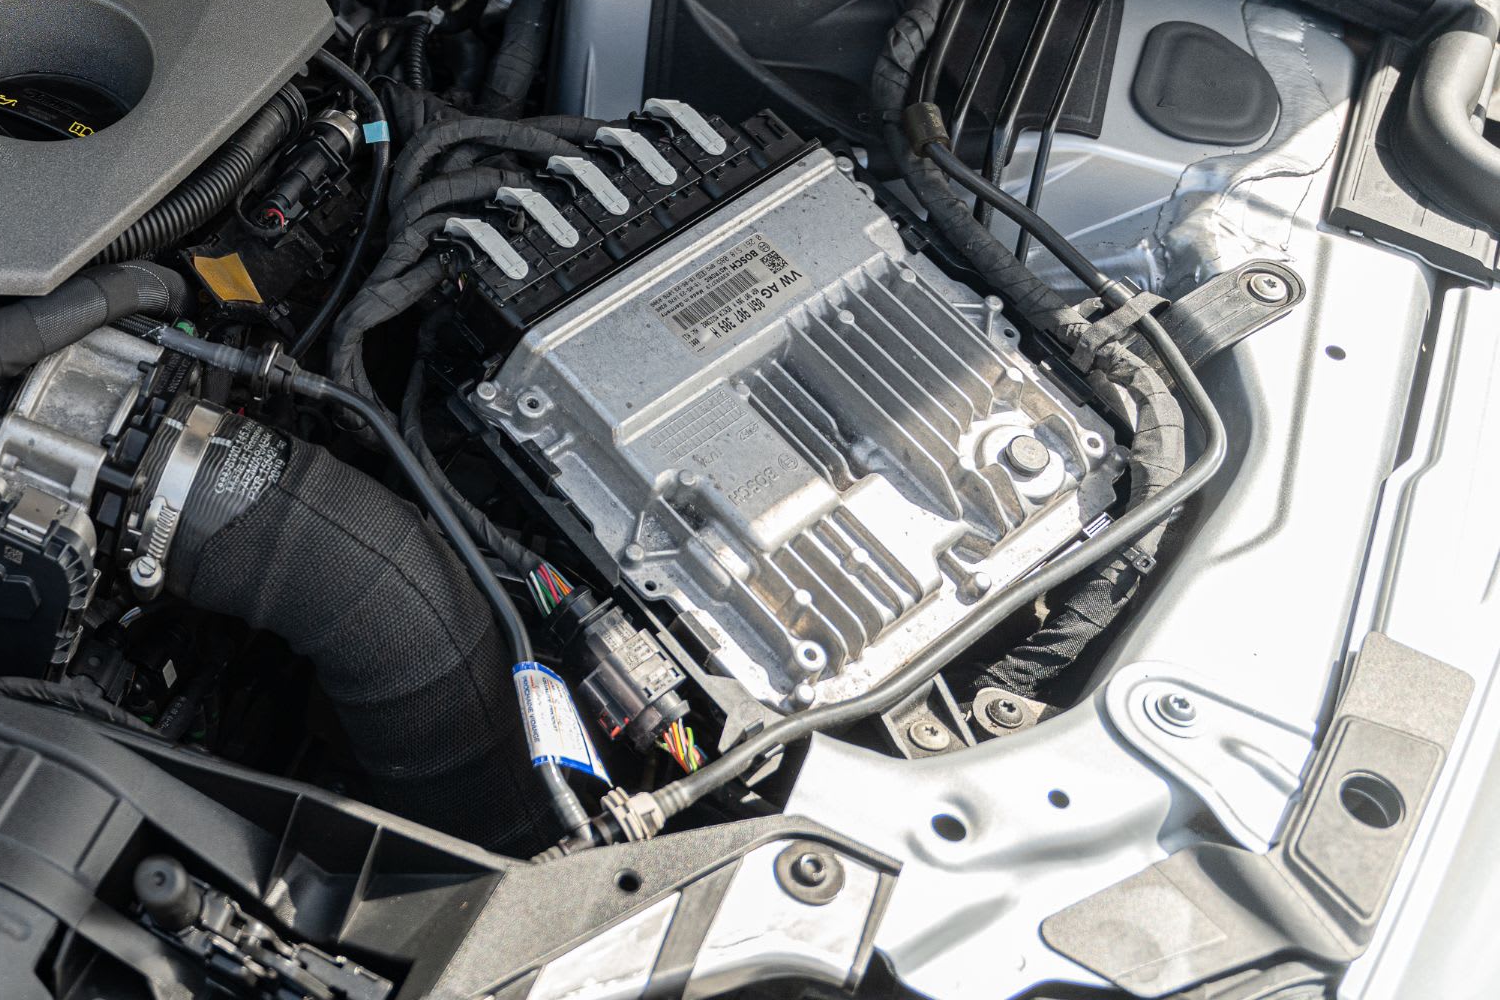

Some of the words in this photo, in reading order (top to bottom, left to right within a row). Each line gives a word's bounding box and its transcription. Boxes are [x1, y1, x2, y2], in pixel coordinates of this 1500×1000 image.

[728, 249, 757, 271] BOSCH
[779, 269, 802, 287] VW
[760, 282, 778, 300] AG
[747, 296, 765, 314] 06M
[732, 305, 751, 324] 907
[717, 317, 736, 334] 309
[726, 465, 779, 507] BOSCH
